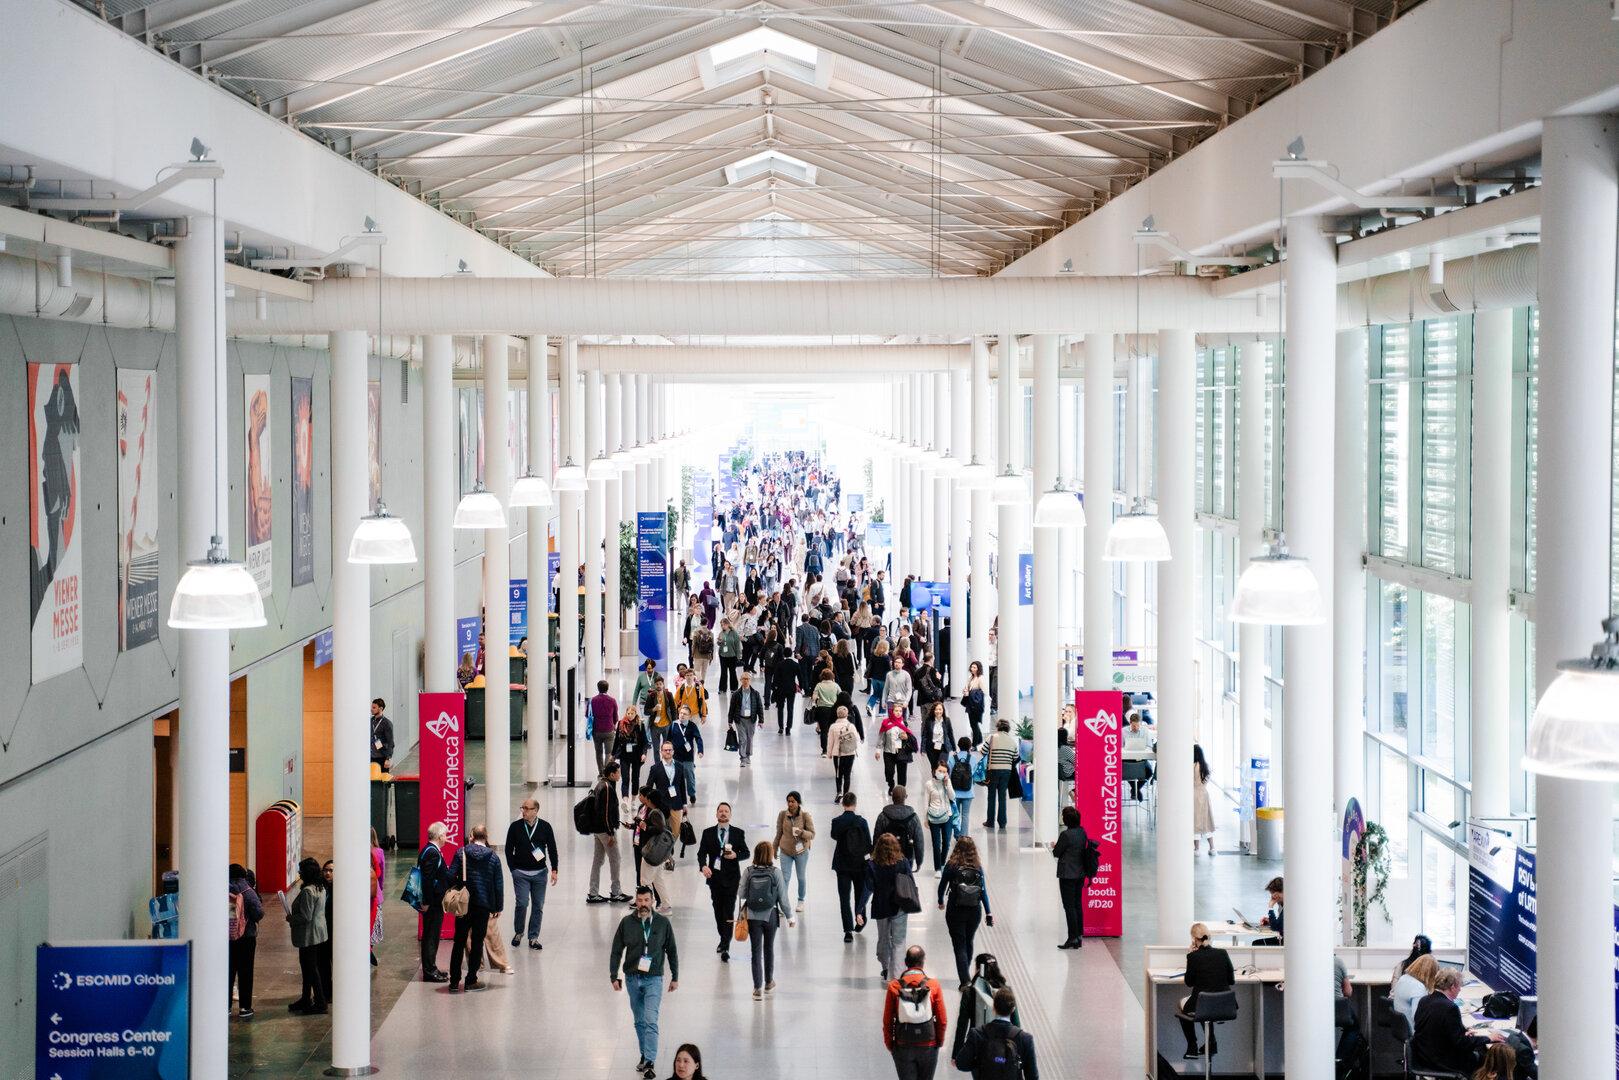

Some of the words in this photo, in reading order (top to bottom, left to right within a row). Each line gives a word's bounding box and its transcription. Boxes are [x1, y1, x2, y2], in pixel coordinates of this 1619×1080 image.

[513, 589, 520, 599] 9
[52, 604, 79, 640] MESSE
[466, 629, 472, 641] 9
[443, 736, 459, 846] AstraZeneca
[1101, 734, 1118, 844] AstraZeneca
[1097, 863, 1112, 872] sit
[1088, 887, 1116, 896] booth
[1088, 900, 1114, 909] #D20
[76, 974, 132, 986] ESCMID
[134, 974, 175, 985] Global
[49, 1030, 120, 1046] Congress
[121, 1029, 172, 1043] Center
[49, 1047, 94, 1058] Session
[97, 1046, 125, 1057] Halls
